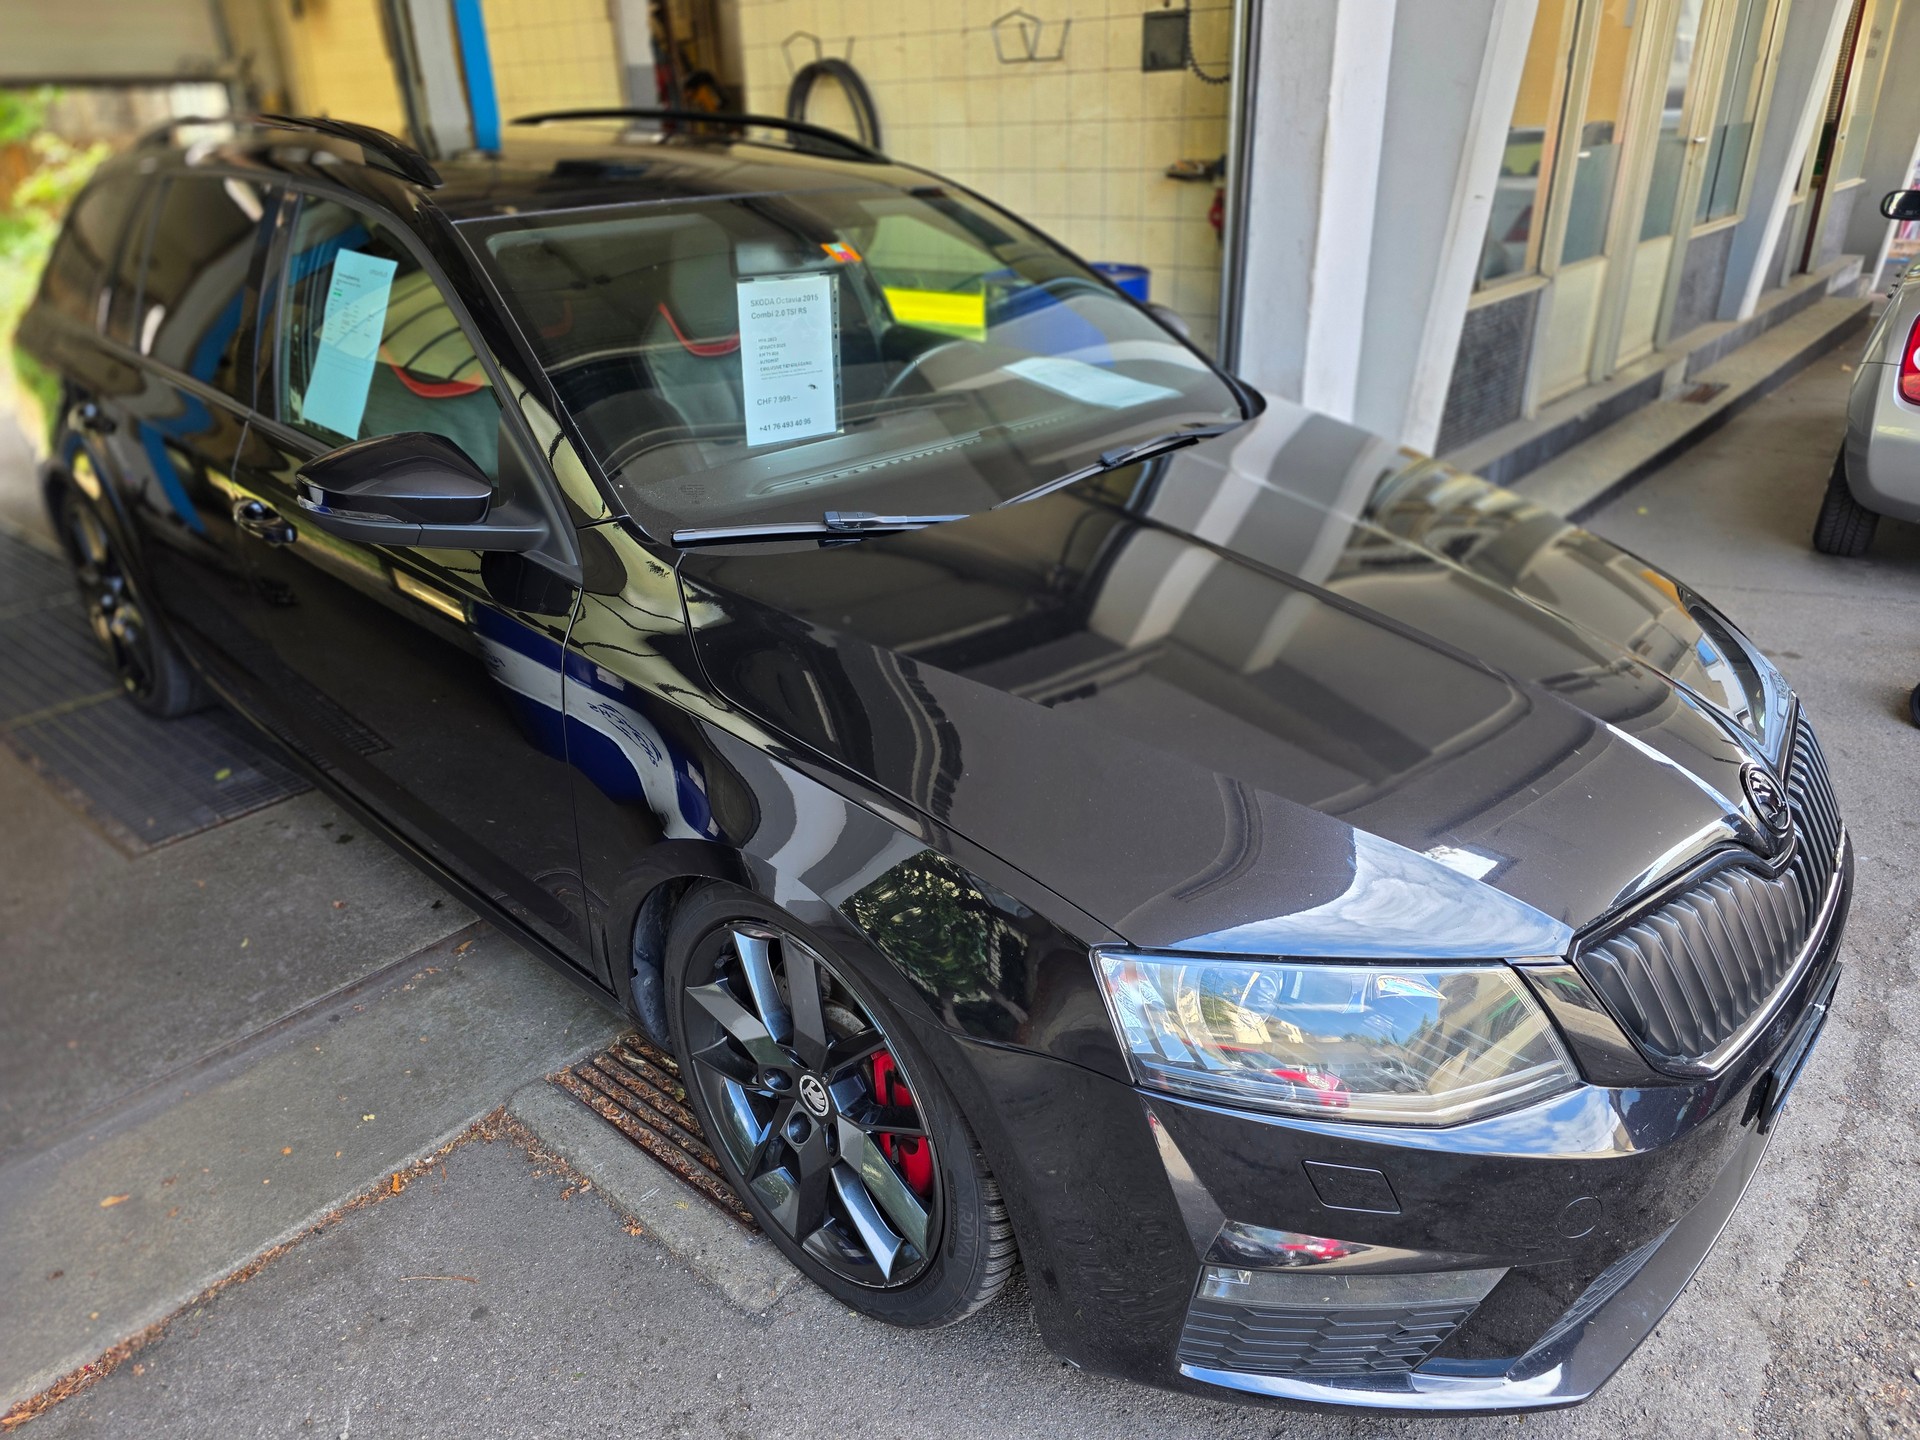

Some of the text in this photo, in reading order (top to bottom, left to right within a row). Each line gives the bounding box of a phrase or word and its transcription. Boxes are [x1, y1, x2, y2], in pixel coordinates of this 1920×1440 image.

[776, 296, 802, 305] Octavia
[803, 294, 819, 303] 2015
[751, 311, 774, 320] Combi
[775, 309, 785, 318] 2.0
[786, 308, 797, 316] TSI
[757, 397, 772, 406] CHF
[782, 421, 794, 429] 493
